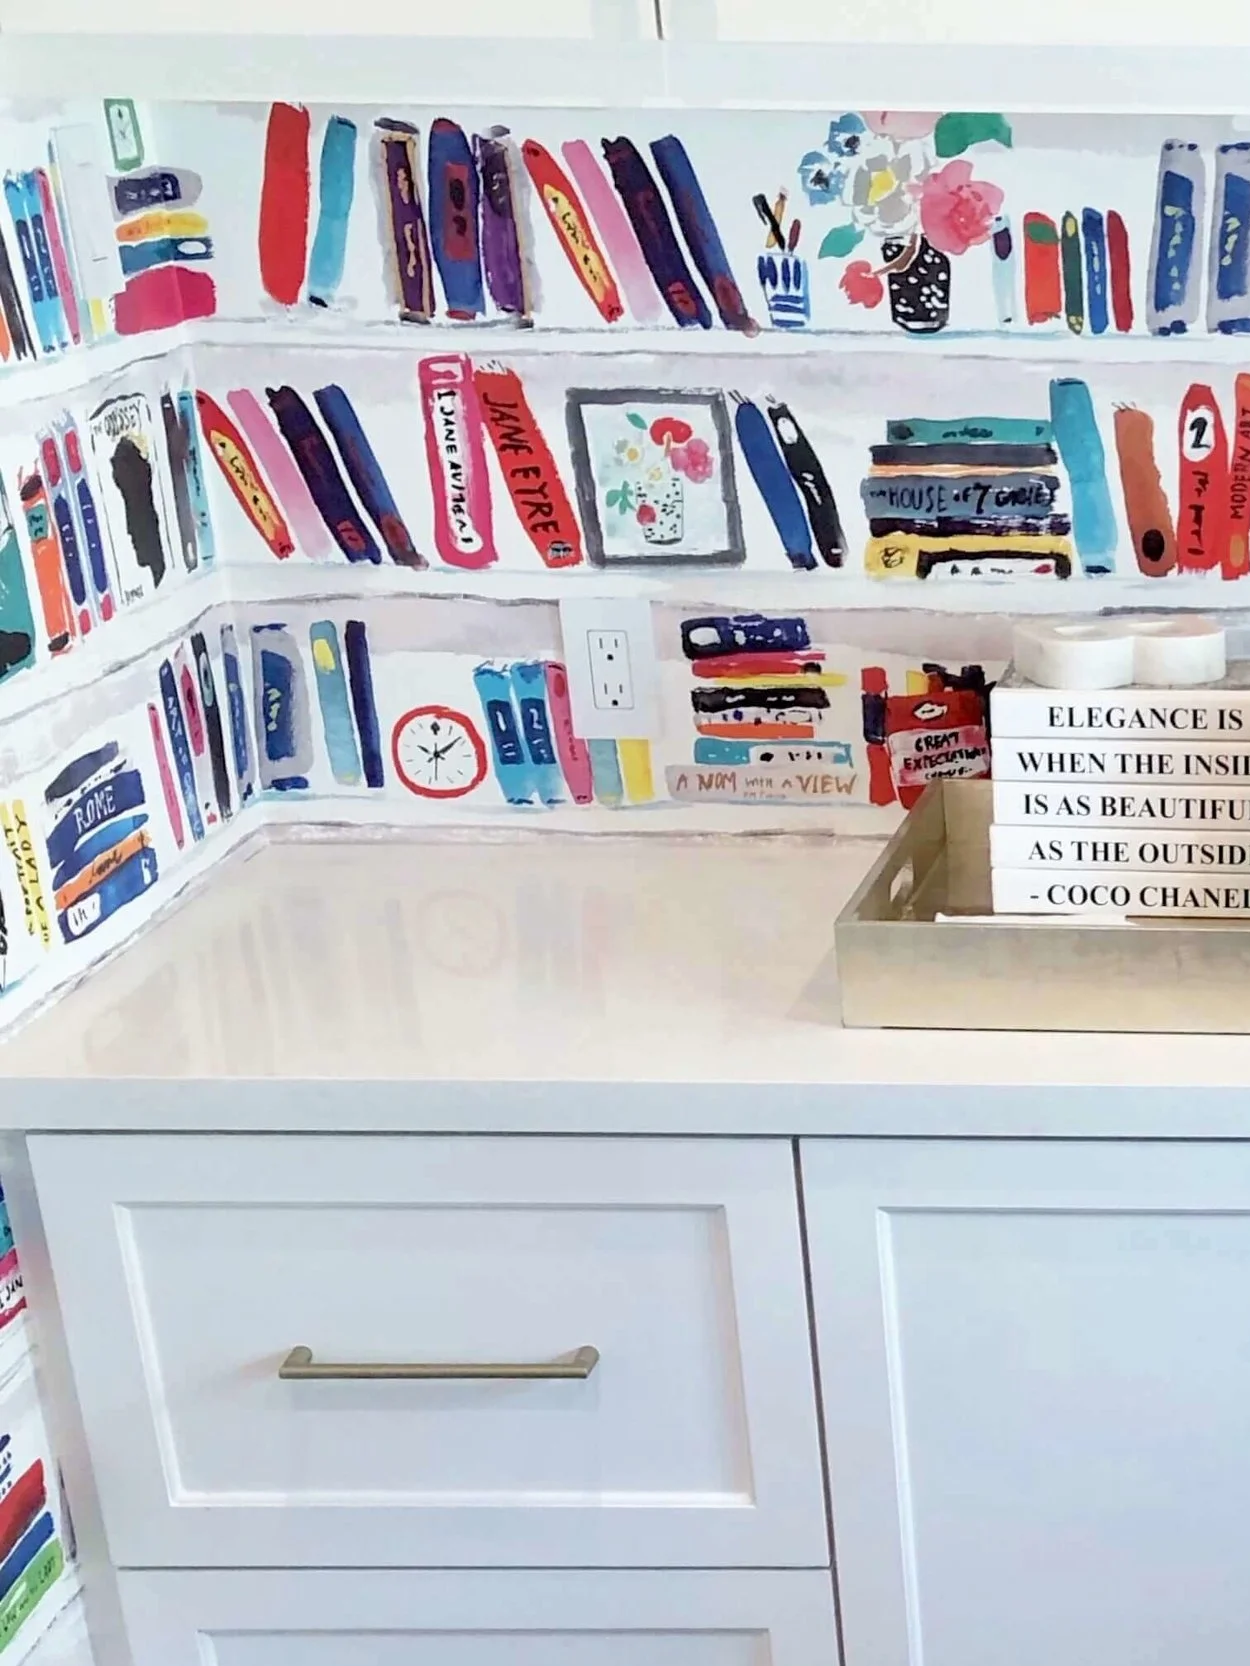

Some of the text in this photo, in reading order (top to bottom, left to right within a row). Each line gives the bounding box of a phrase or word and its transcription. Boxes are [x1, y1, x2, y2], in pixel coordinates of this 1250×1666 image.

[1189, 417, 1212, 450] 2
[482, 392, 561, 535] JANE EYRE
[889, 485, 948, 513] HOUSE
[973, 482, 993, 515] 7
[1048, 706, 1243, 730] ELEGANCE IS
[914, 731, 960, 753] GREAT
[1017, 752, 1108, 774] WHEN
[1114, 754, 1174, 776] THE
[676, 773, 689, 792] A
[795, 773, 858, 796] VIEW
[73, 785, 117, 834] ROME
[1024, 794, 1048, 815] IS
[1056, 795, 1091, 816] AS
[1028, 841, 1063, 861] AS
[1071, 842, 1129, 863] THE
[1047, 885, 1131, 906] COCO
